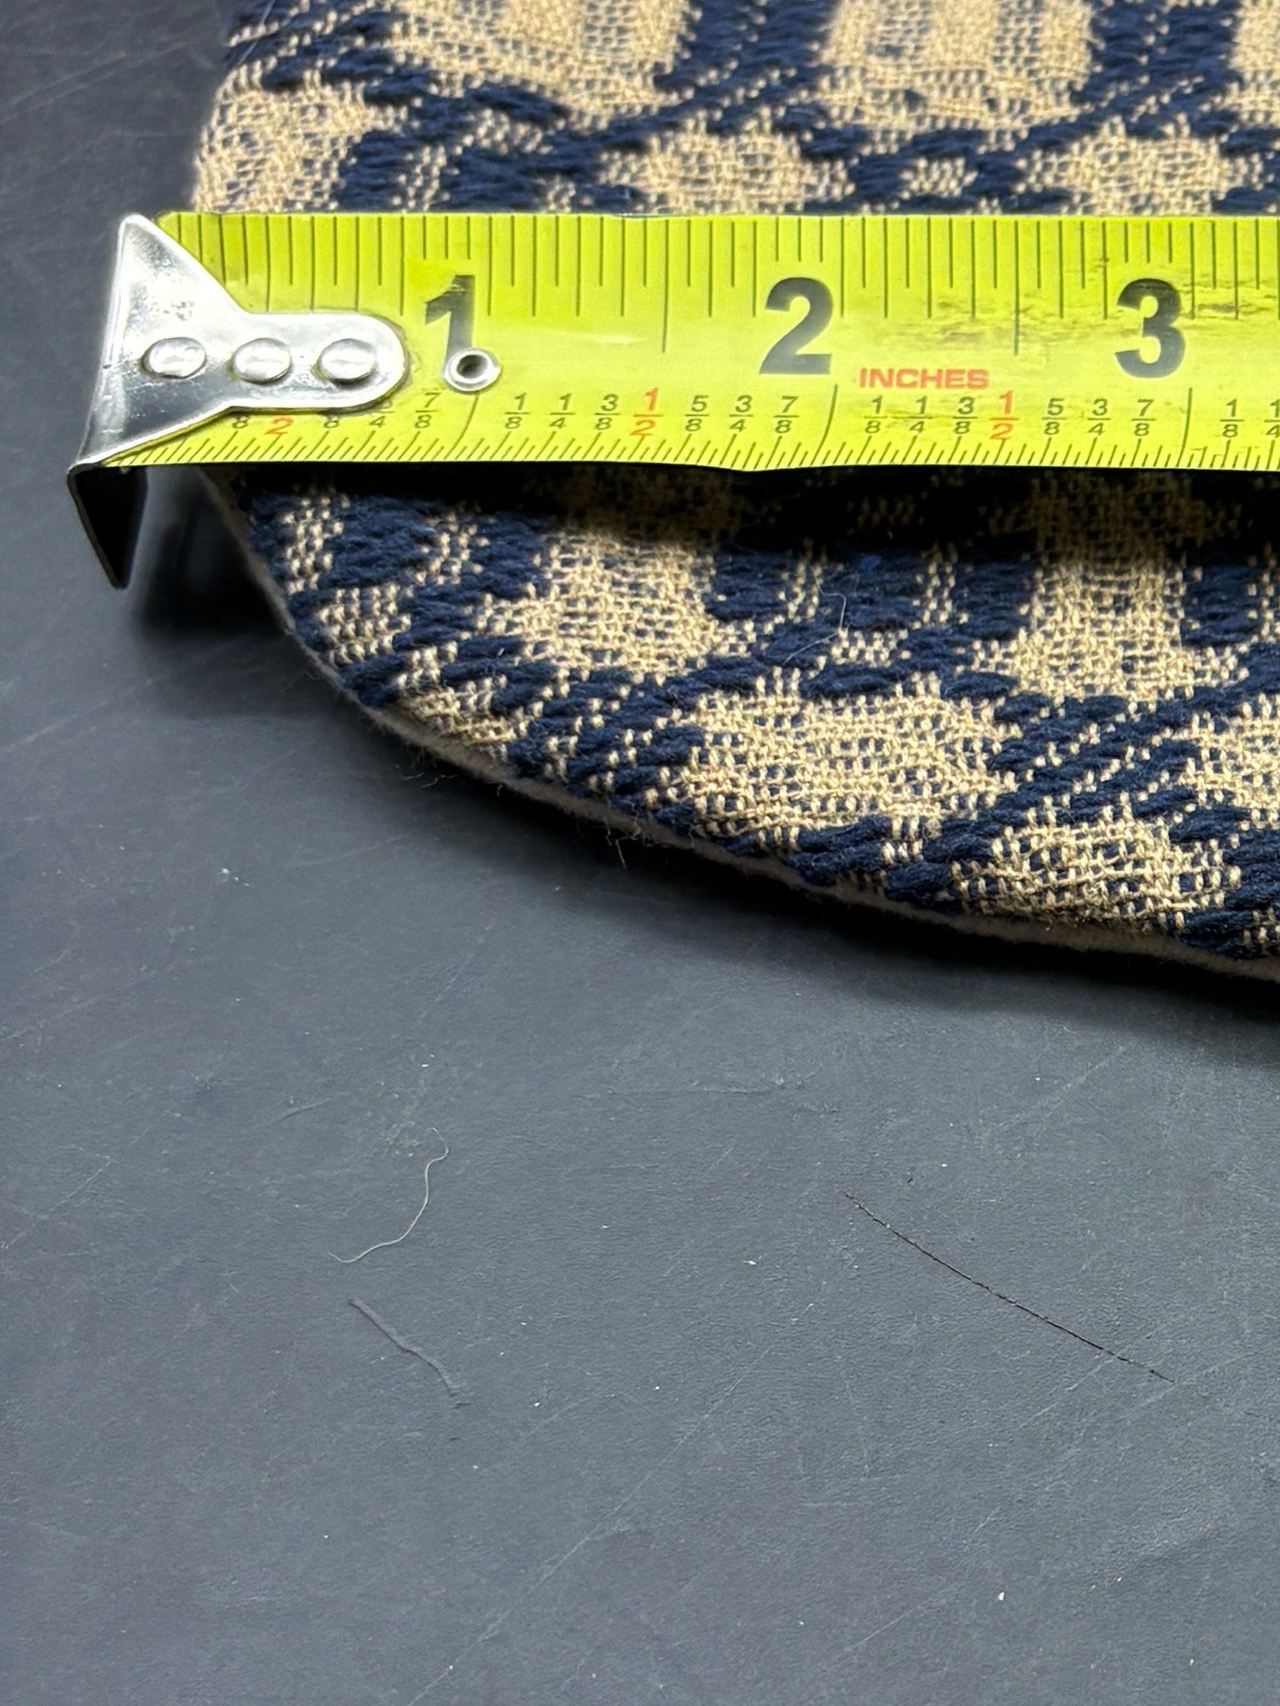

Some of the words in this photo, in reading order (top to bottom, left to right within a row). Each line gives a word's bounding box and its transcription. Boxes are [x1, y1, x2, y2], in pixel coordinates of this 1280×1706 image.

[424, 274, 476, 369] 1
[759, 276, 835, 375] 2
[1114, 277, 1186, 379] 3
[858, 367, 989, 390] INCHES
